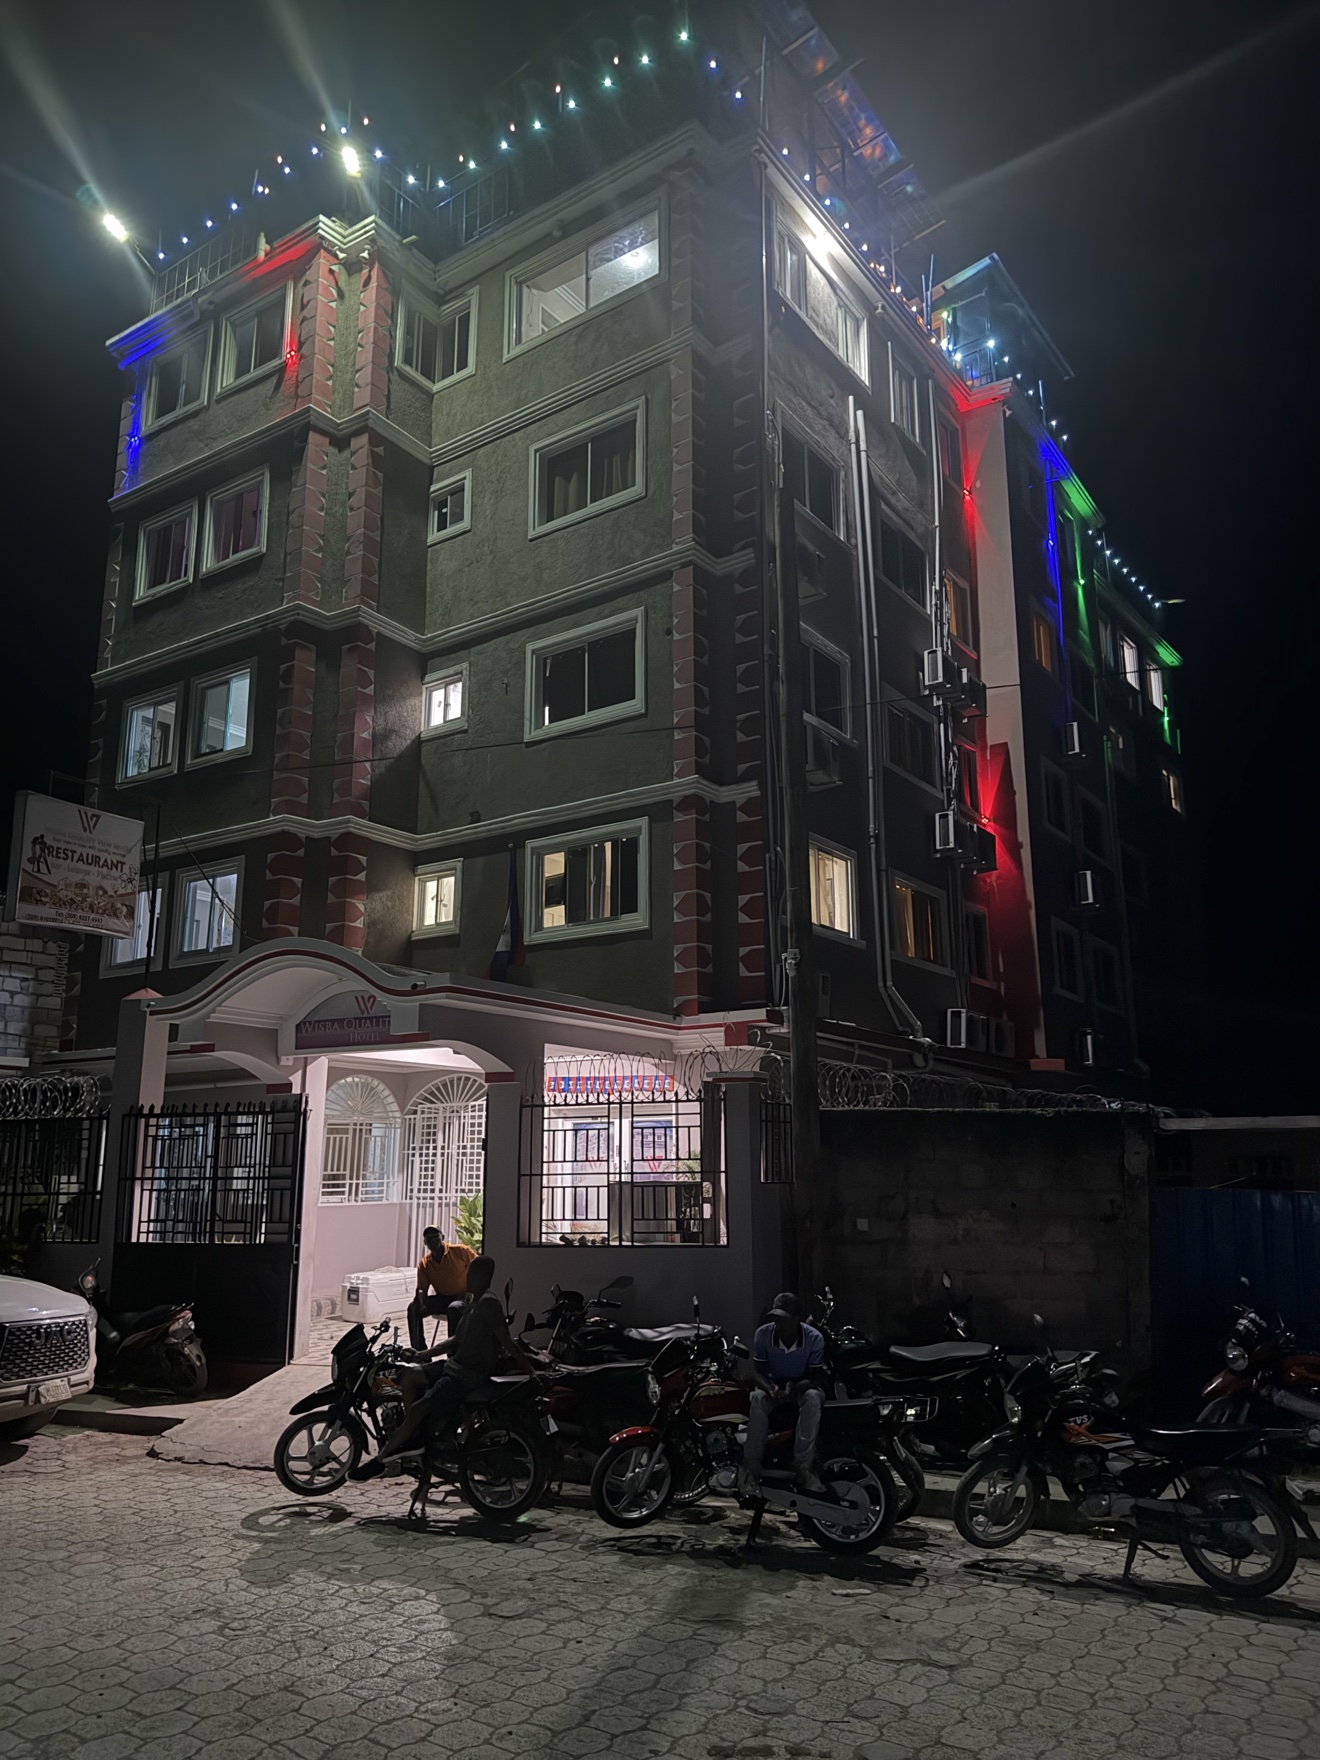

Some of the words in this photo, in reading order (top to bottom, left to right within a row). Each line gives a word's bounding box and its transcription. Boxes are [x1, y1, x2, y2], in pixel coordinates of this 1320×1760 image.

[46, 844, 126, 873] RESTAURANT
[343, 1017, 391, 1031] QUALIT
[34, 1325, 76, 1346] JAC
[378, 1368, 396, 1378] TVS
[1068, 1414, 1089, 1425] TVS
